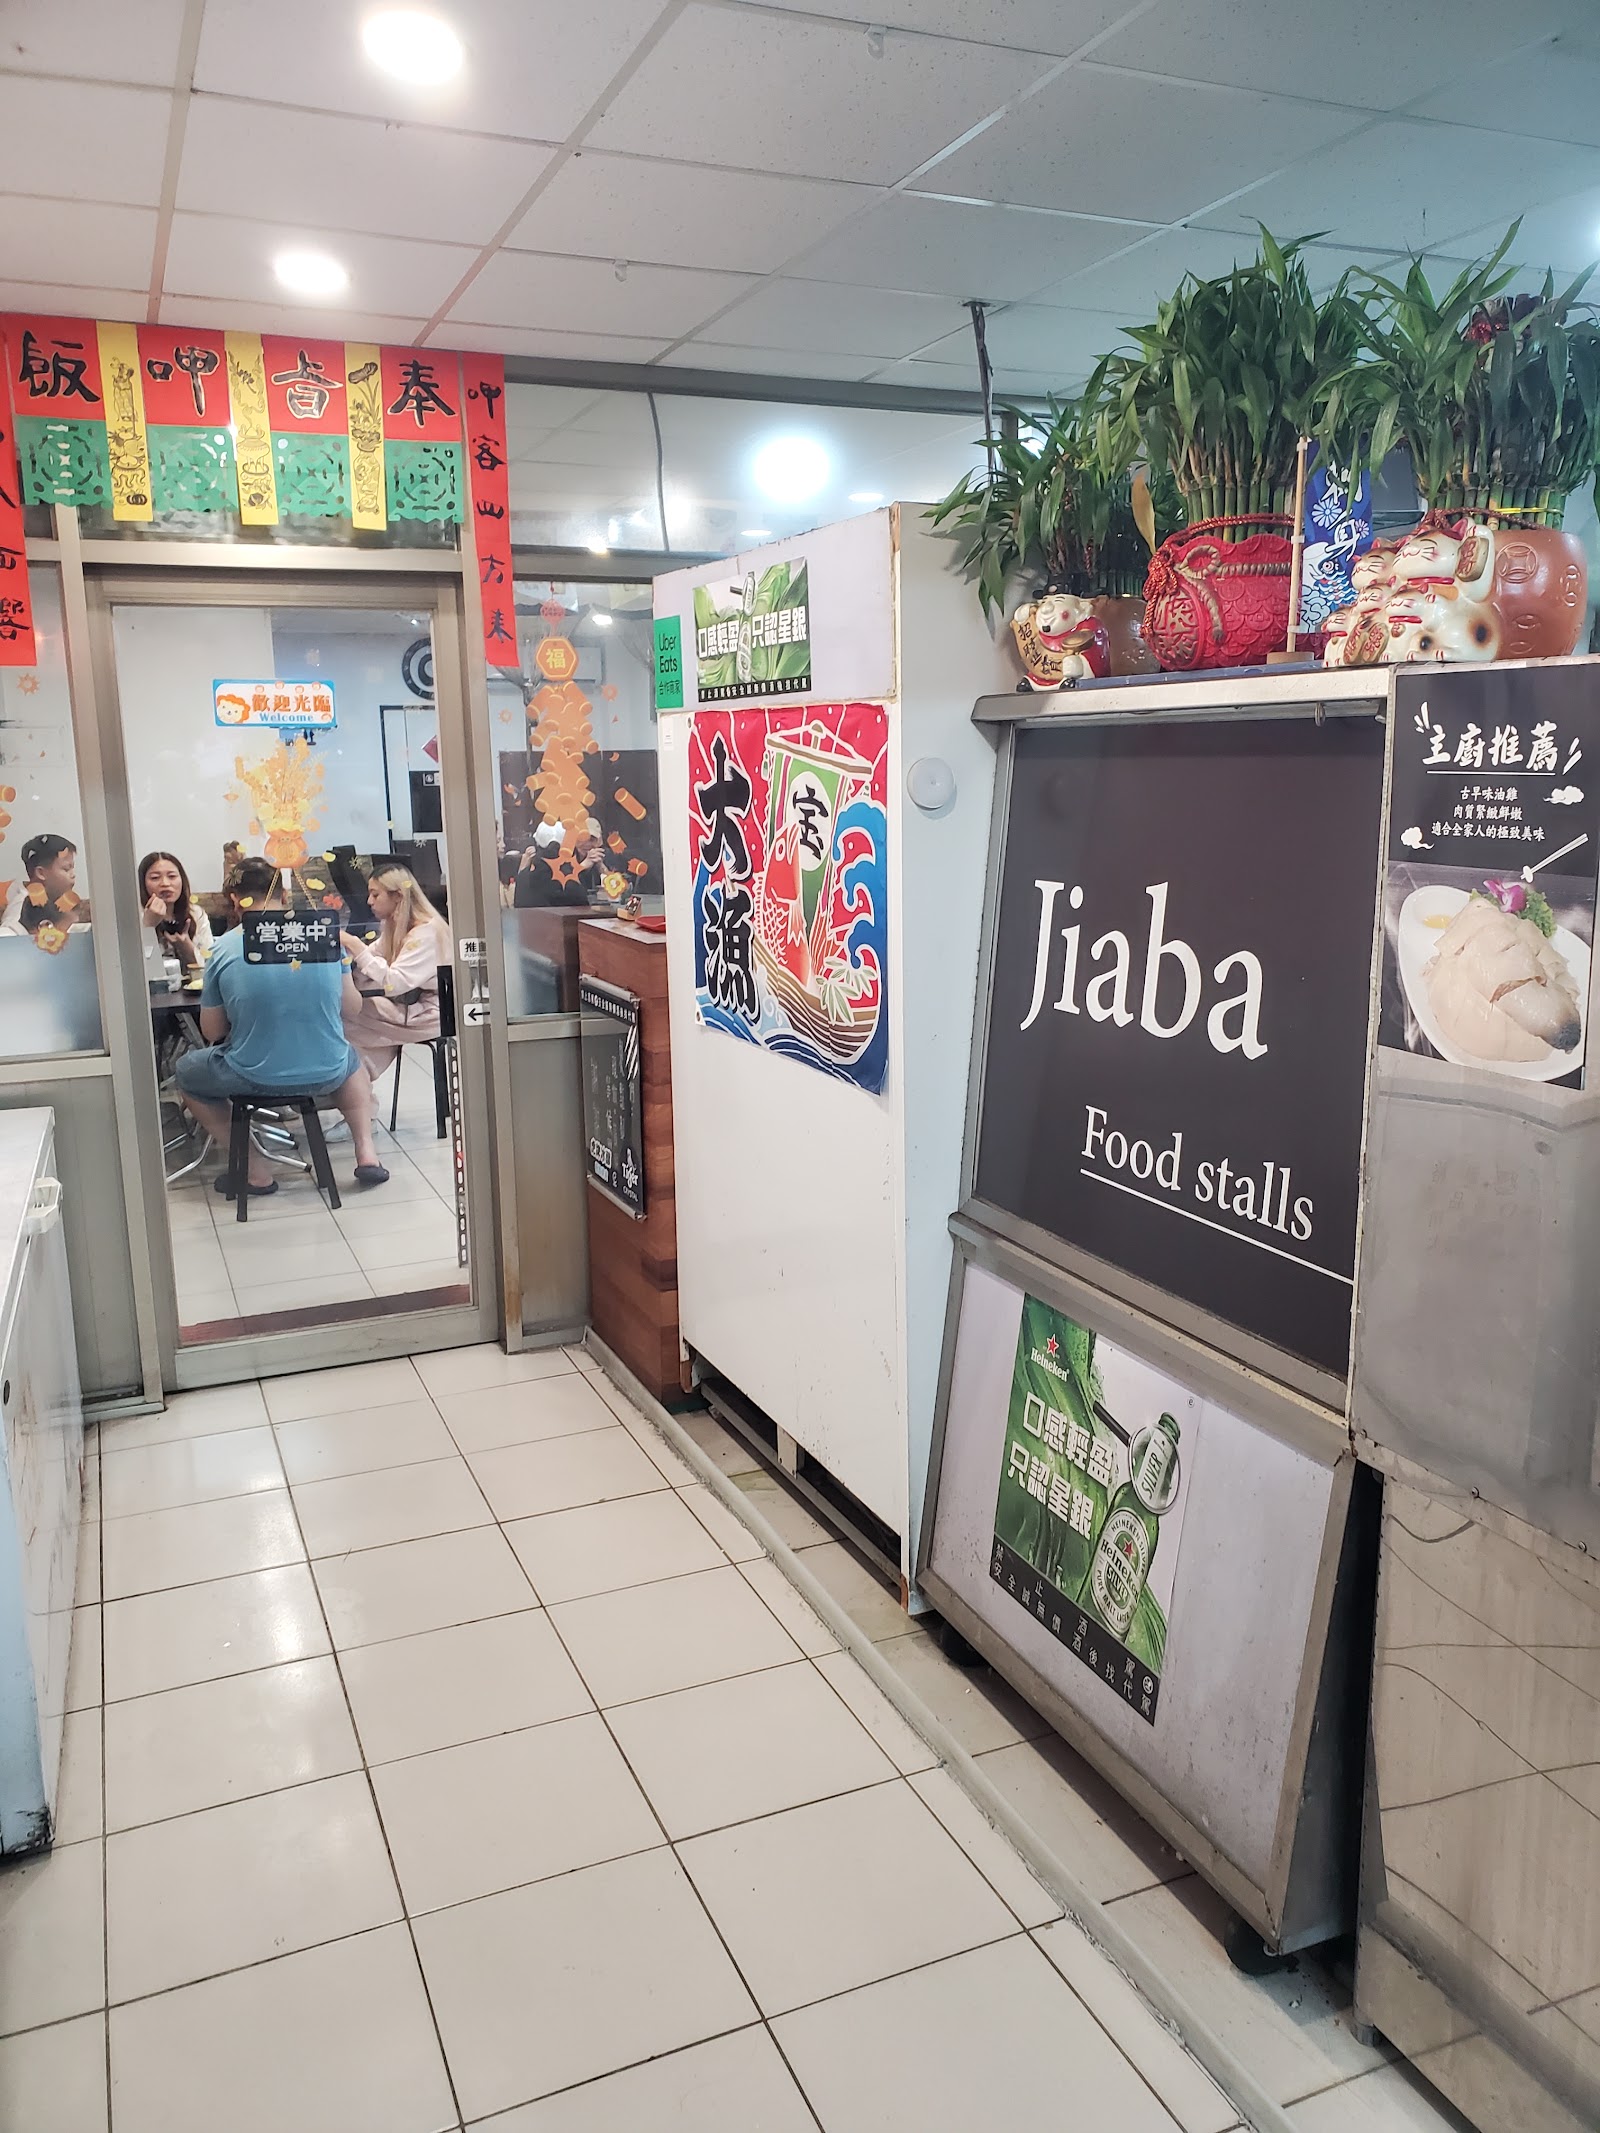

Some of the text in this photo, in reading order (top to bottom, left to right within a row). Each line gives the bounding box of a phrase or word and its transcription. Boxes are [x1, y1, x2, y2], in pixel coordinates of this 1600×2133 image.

[658, 633, 677, 651] Uber
[546, 648, 566, 669] 福
[659, 655, 678, 673] Eats
[252, 694, 331, 712] 歡迎光臨
[259, 713, 314, 722] Welcome
[1422, 720, 1559, 772] 主廚推薦
[1460, 785, 1519, 801] 古早味油雞
[1431, 821, 1546, 842] 適合全家人的極致美味
[275, 943, 309, 953] OPEN
[1020, 879, 1268, 1060] Jiaba
[1081, 1105, 1314, 1240] Food stalls
[1031, 1347, 1069, 1382] Heineken
[1023, 1391, 1114, 1488] 口感輕盈
[1141, 1452, 1163, 1500] SILVER
[1007, 1440, 1094, 1540] 只認星銀
[1106, 1564, 1129, 1602] SILVER
[1103, 1594, 1116, 1615] MALT
